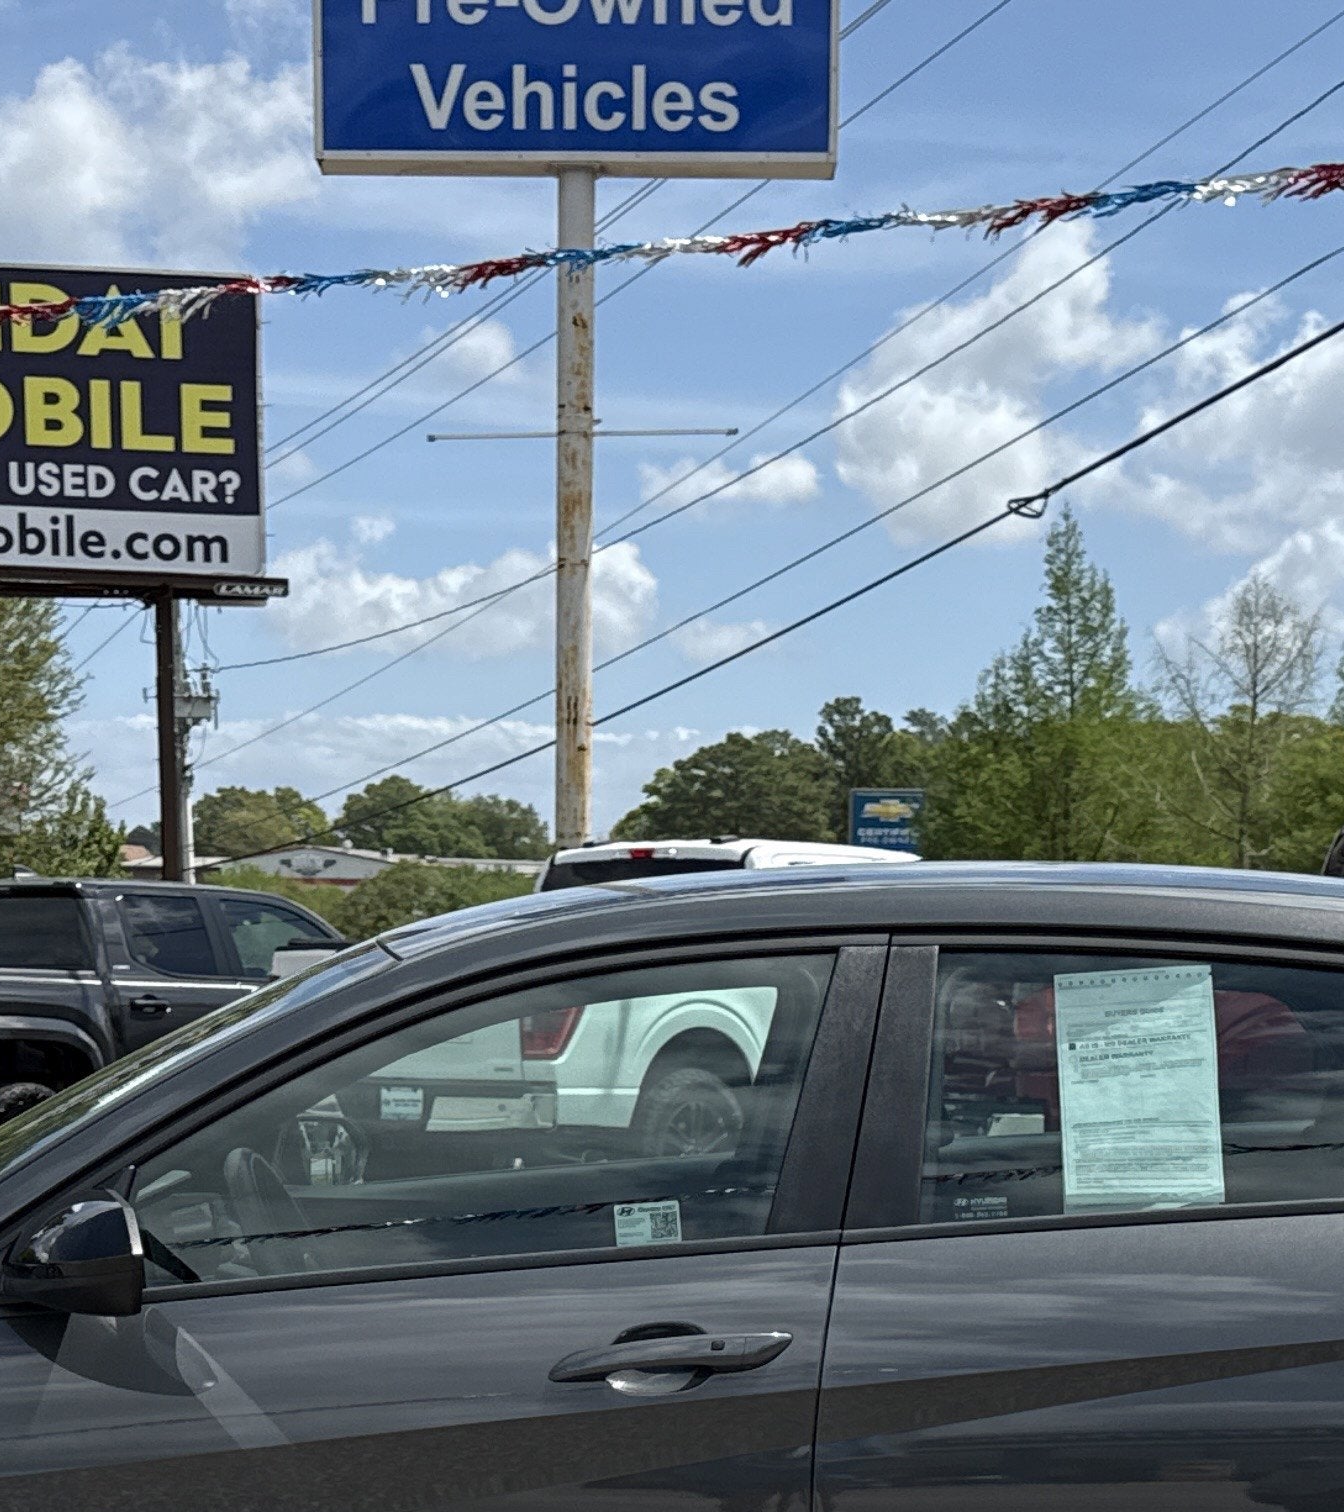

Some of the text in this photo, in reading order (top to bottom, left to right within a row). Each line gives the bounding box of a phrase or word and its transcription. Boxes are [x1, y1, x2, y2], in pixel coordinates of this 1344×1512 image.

[409, 63, 739, 132] Vehicles
[8, 461, 116, 498] USED
[128, 466, 241, 504] CAR?
